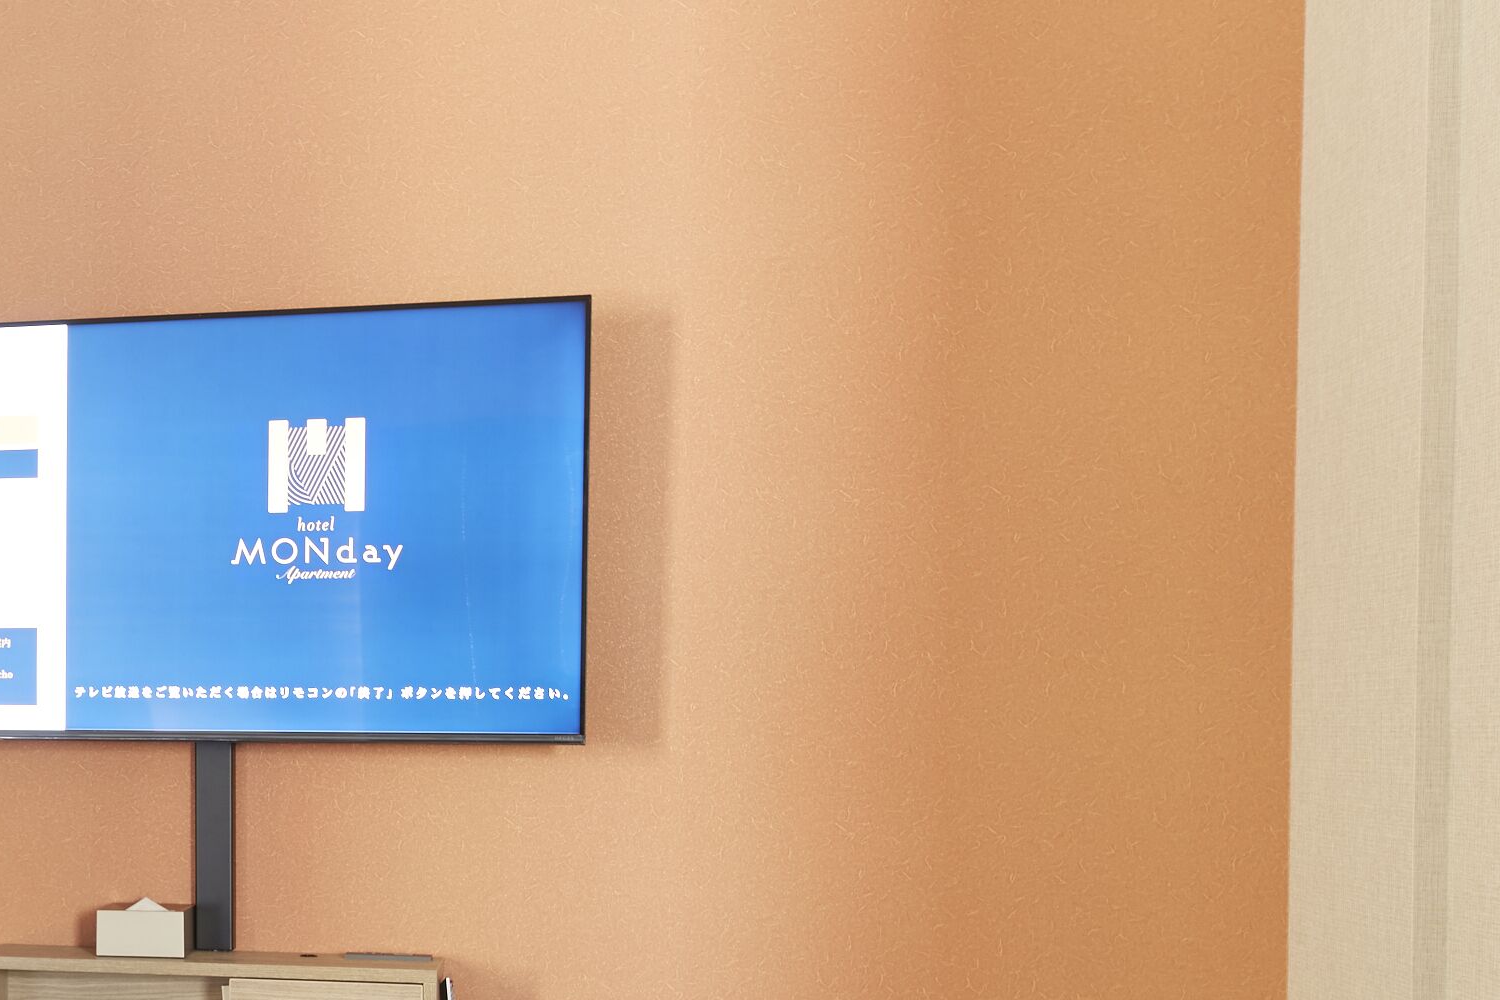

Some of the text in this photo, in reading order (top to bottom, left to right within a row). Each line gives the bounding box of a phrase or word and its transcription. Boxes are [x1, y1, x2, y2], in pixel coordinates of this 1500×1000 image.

[297, 515, 335, 532] hotel
[230, 536, 404, 571] MONday
[275, 565, 357, 585] Apartment
